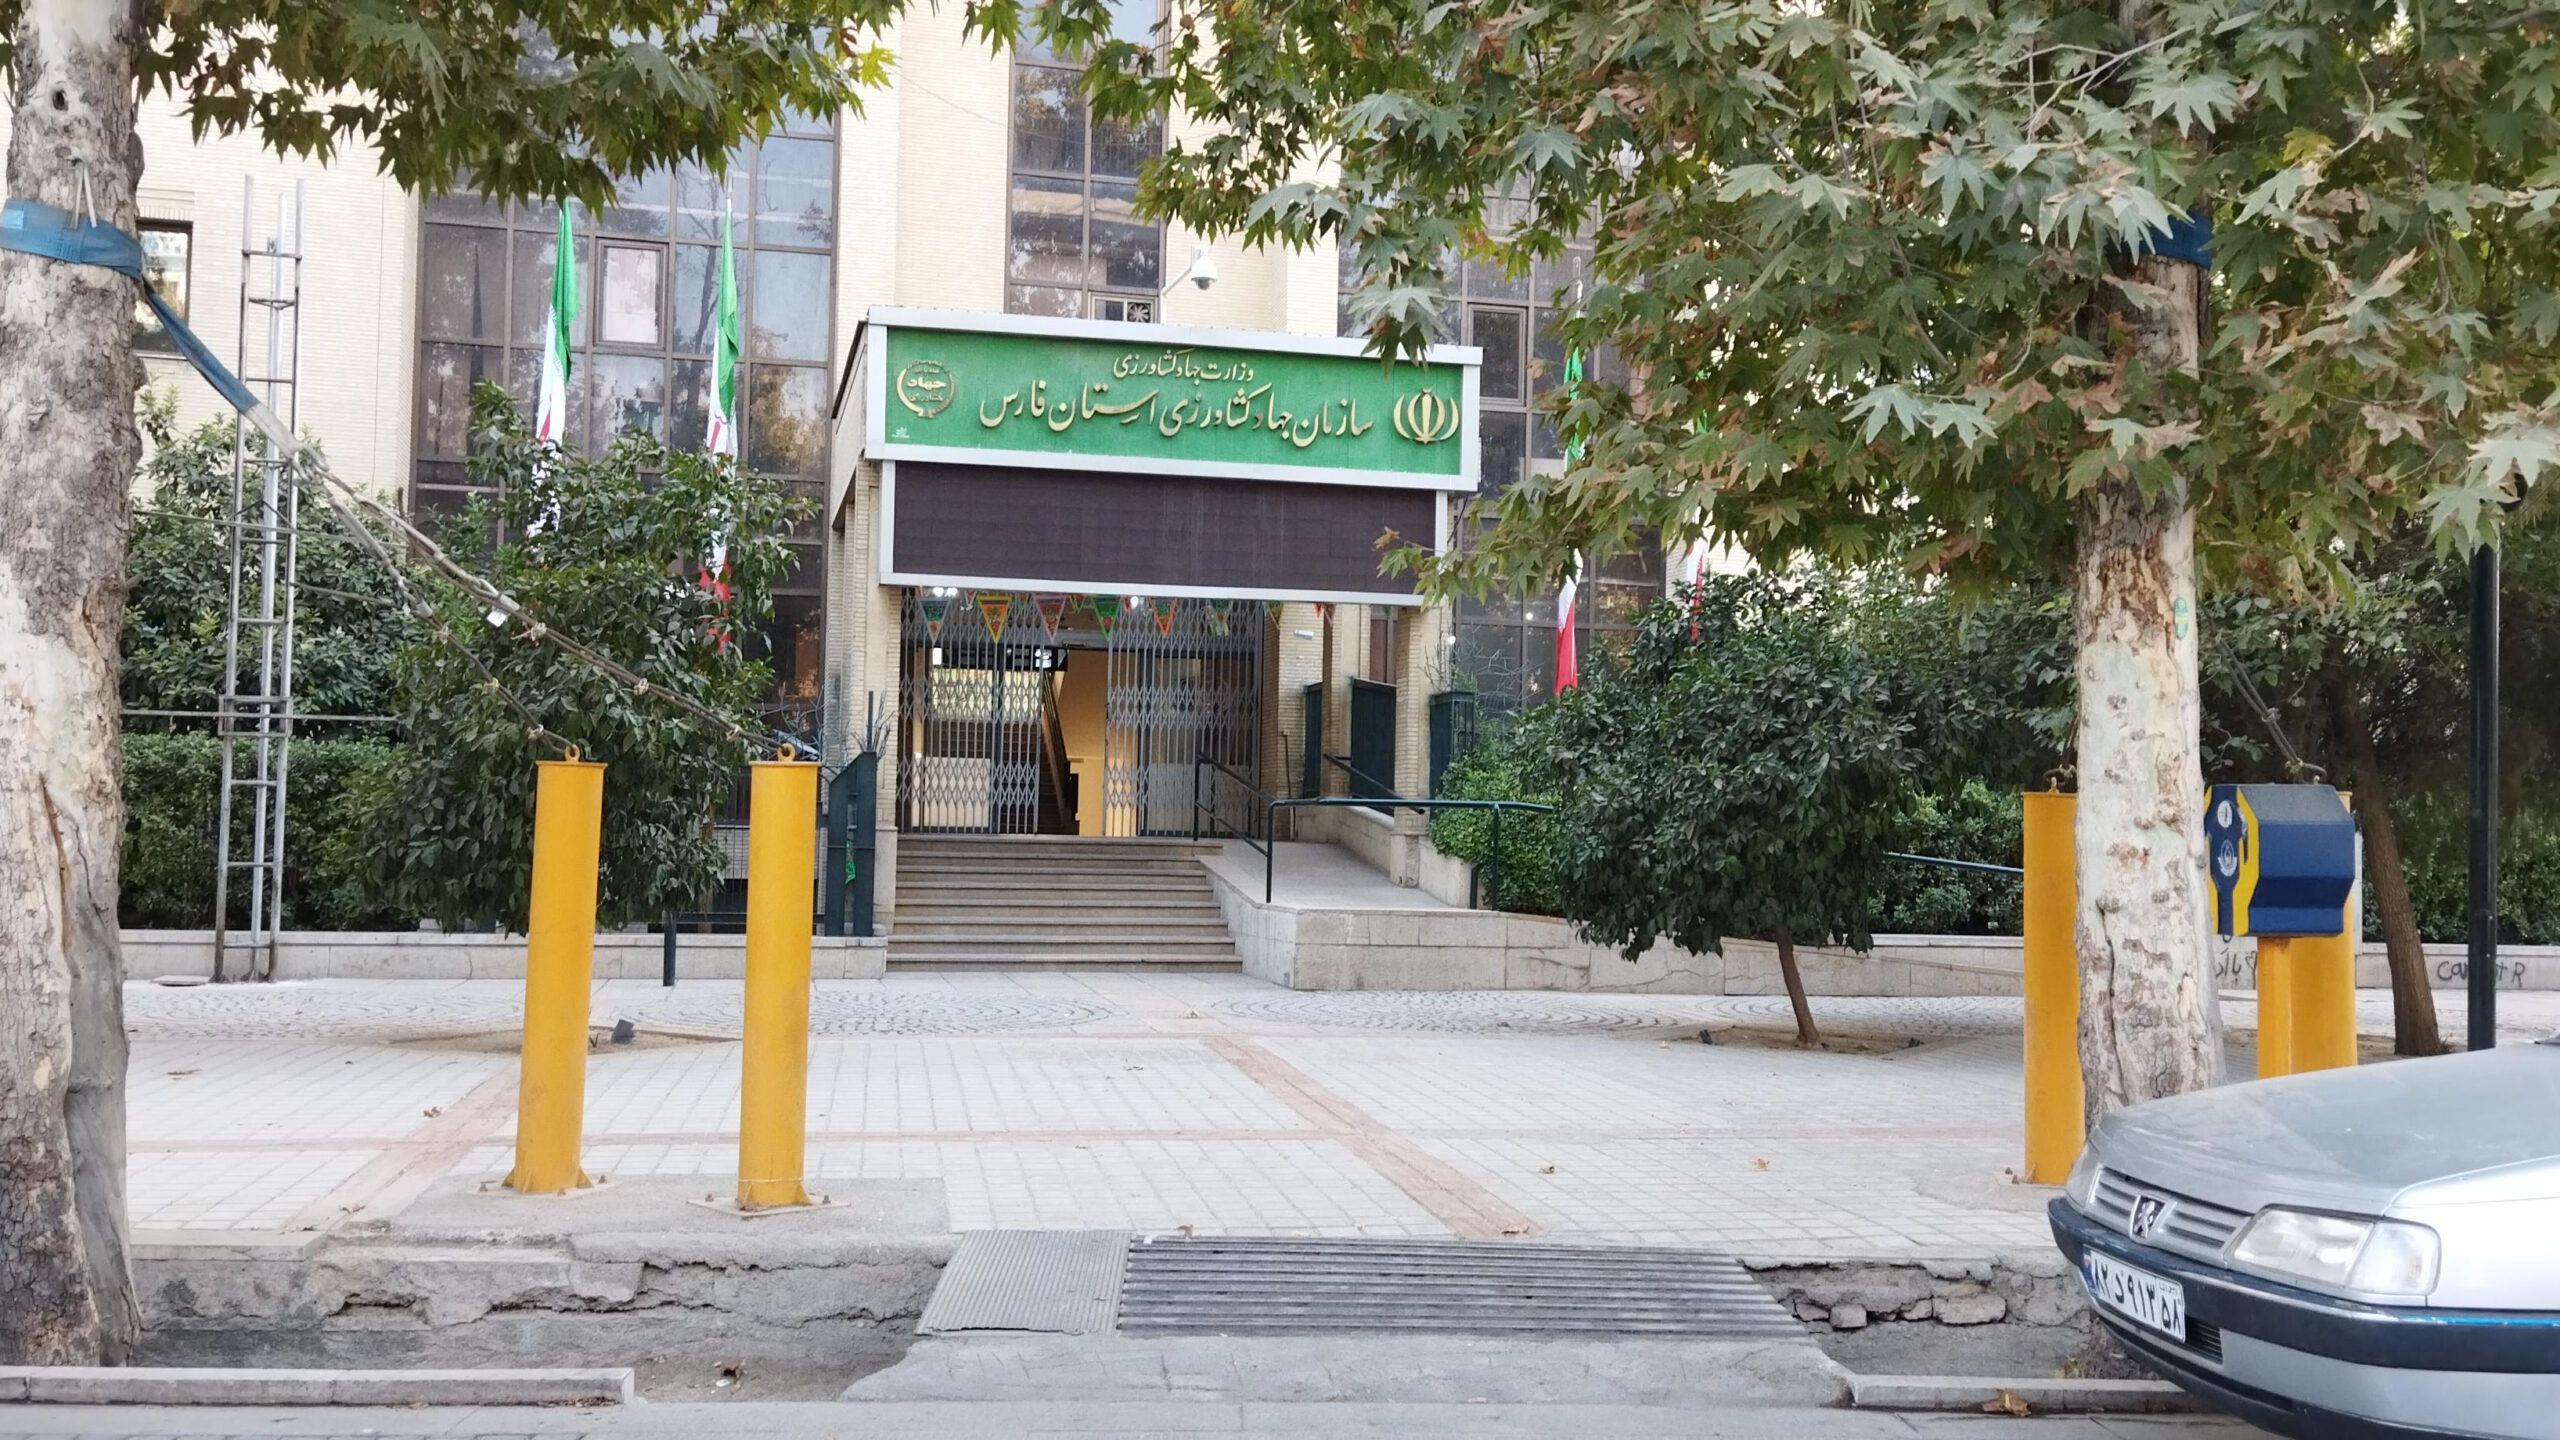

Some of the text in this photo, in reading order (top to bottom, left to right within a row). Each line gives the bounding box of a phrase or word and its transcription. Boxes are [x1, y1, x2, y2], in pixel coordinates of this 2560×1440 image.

[906, 376, 947, 391] جهاد
[1113, 347, 1254, 386] وزارت جهاد کشاورزی
[979, 379, 1374, 448] سازمان جهاد کشاورزی استان فارس
